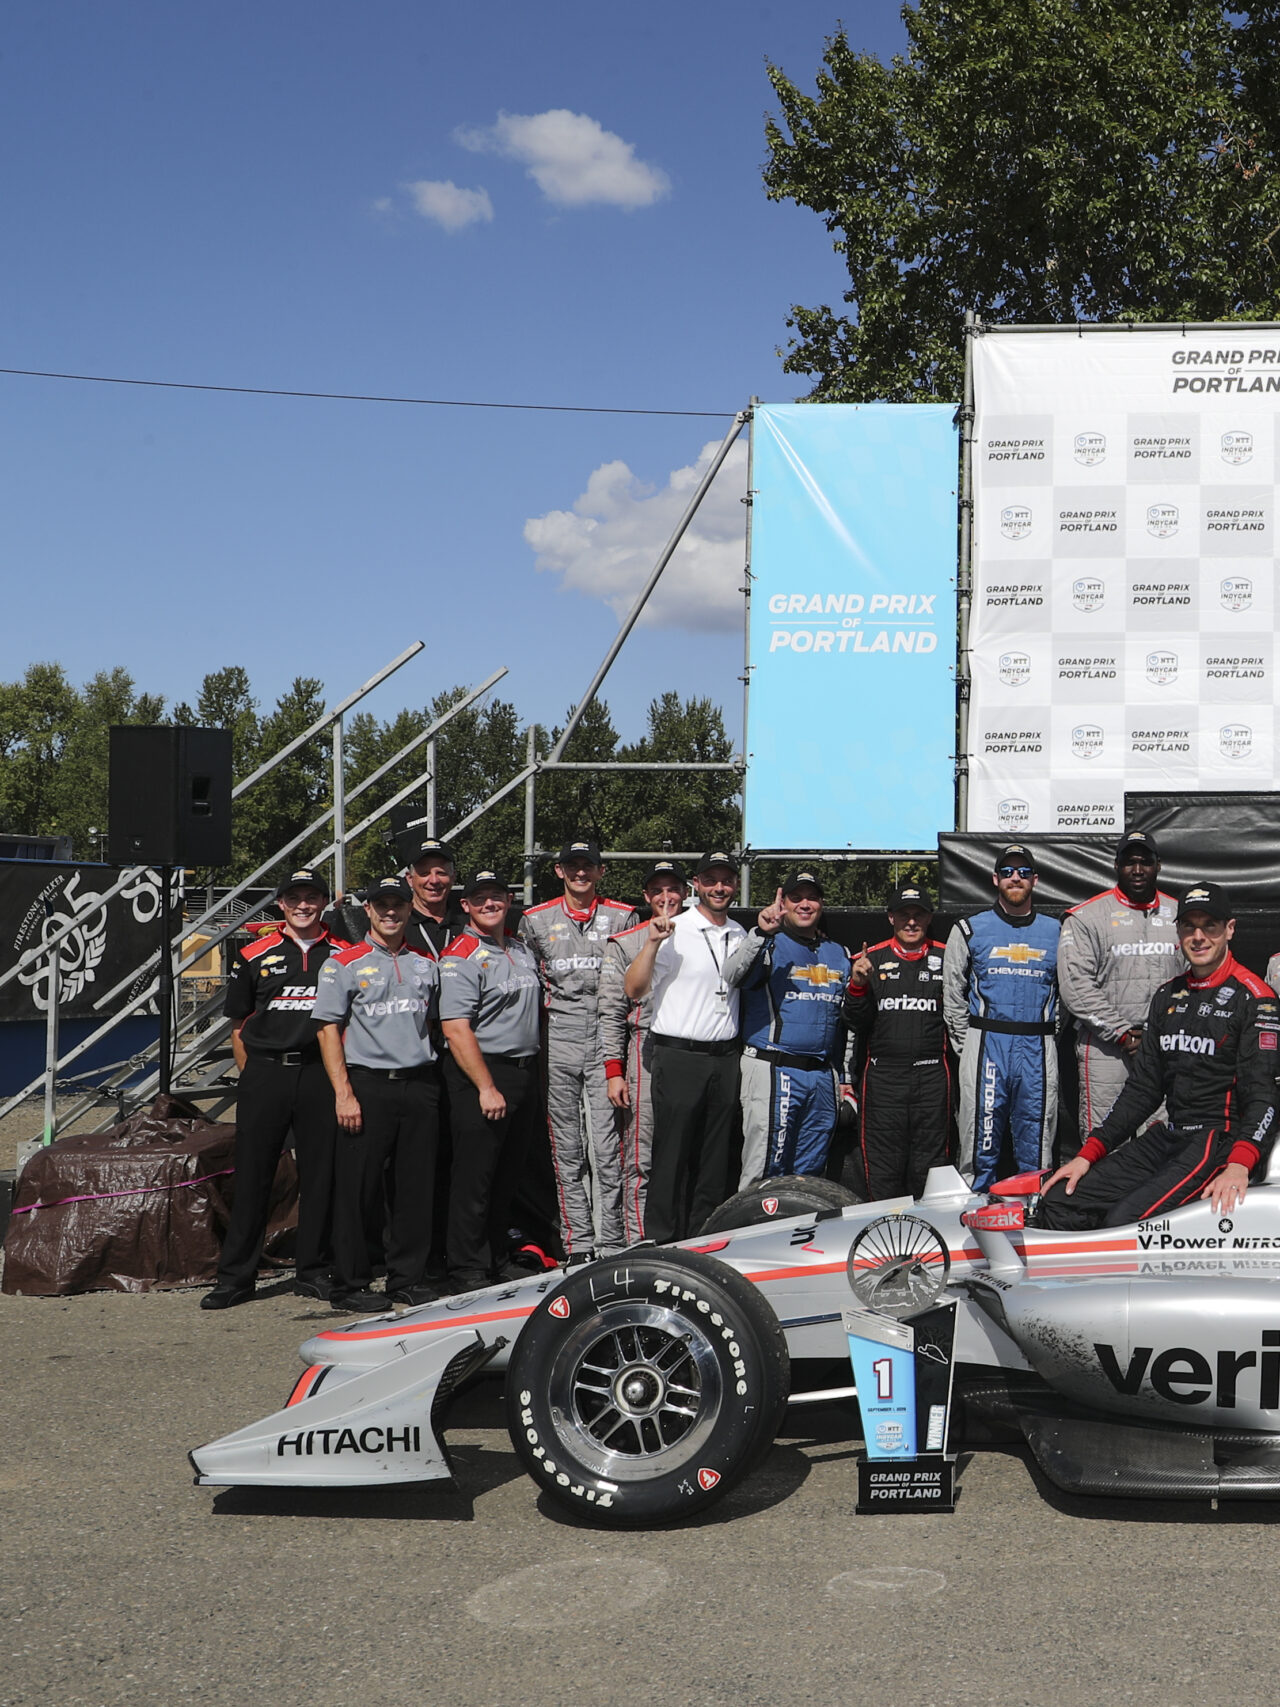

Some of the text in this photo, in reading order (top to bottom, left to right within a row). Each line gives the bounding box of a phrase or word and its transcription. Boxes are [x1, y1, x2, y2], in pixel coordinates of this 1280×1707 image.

[1171, 350, 1244, 365] GRAND
[1228, 367, 1242, 375] OF
[988, 439, 1044, 448] GRAND PRIX
[1134, 438, 1191, 446] GRAND PRIX
[989, 452, 1045, 461] PORTLAND
[1134, 450, 1192, 459] PORTLAND
[1060, 511, 1117, 519] GRAND PRIX
[1207, 510, 1264, 518] GRAND PRIX
[1060, 523, 1118, 532] PORTLAND
[1208, 522, 1265, 531] PORTLAND
[986, 584, 1042, 593] GRAND PRIX
[1133, 583, 1190, 592] GRAND PRIX
[768, 594, 937, 614] GRAND PRIX
[987, 597, 1044, 606] PORTLAND
[1133, 596, 1191, 605] PORTLAND
[842, 618, 861, 628] OF
[768, 631, 938, 653] PORTLAND
[1059, 658, 1116, 666] GRAND PRIX
[1207, 657, 1264, 665] GRAND PRIX
[1059, 670, 1117, 679] PORTLAND
[1207, 670, 1265, 678] PORTLAND
[985, 731, 1042, 740] GRAND PRIX
[1132, 730, 1189, 739] GRAND PRIX
[985, 744, 1043, 753] PORTLAND
[1132, 743, 1190, 752] PORTLAND
[1057, 804, 1114, 813] GRAND PRIX
[1058, 817, 1116, 826] PORTLAND
[13, 874, 66, 951] FIRESTONE WALKER
[1111, 939, 1175, 956] verizon
[988, 967, 1045, 978] CHEVROLET
[281, 986, 318, 997] TEA
[267, 1000, 316, 1011] PENS
[982, 1059, 997, 1151] CHEVROLET
[1137, 1219, 1171, 1233] Shell
[1138, 1234, 1227, 1250] V-Power
[652, 1278, 748, 1397] Firestone
[873, 1358, 893, 1400] 1
[277, 1425, 421, 1457] HITACHI
[518, 1389, 614, 1509] Firestone
[870, 1472, 942, 1482] GRAND PRIX
[870, 1489, 942, 1499] PORTLAND
